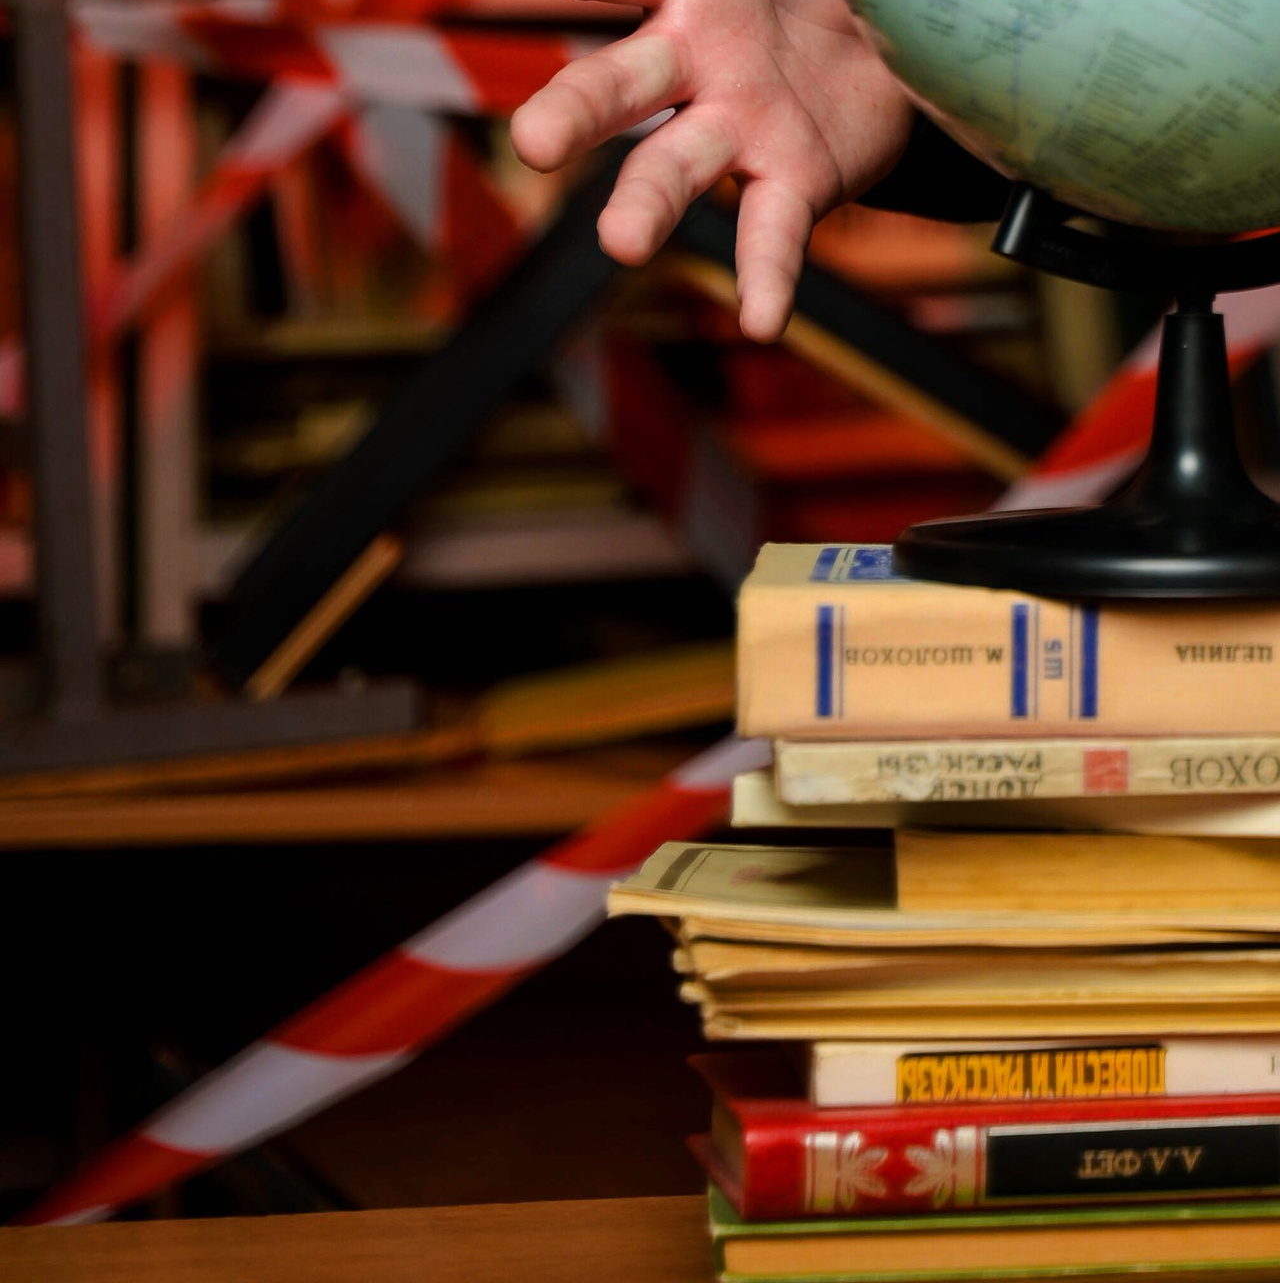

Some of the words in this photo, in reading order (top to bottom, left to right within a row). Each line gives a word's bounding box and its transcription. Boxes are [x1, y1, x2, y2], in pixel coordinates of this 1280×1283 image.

[845, 647, 973, 666] ШОЛОХОВ
[978, 647, 1003, 665] М.
[1174, 644, 1273, 664] ЦЕЛИНА
[897, 1053, 1024, 1103] РАССКАЗЫ
[1031, 1052, 1049, 1098] И
[1055, 1047, 1165, 1099] ПОВЕСТИ
